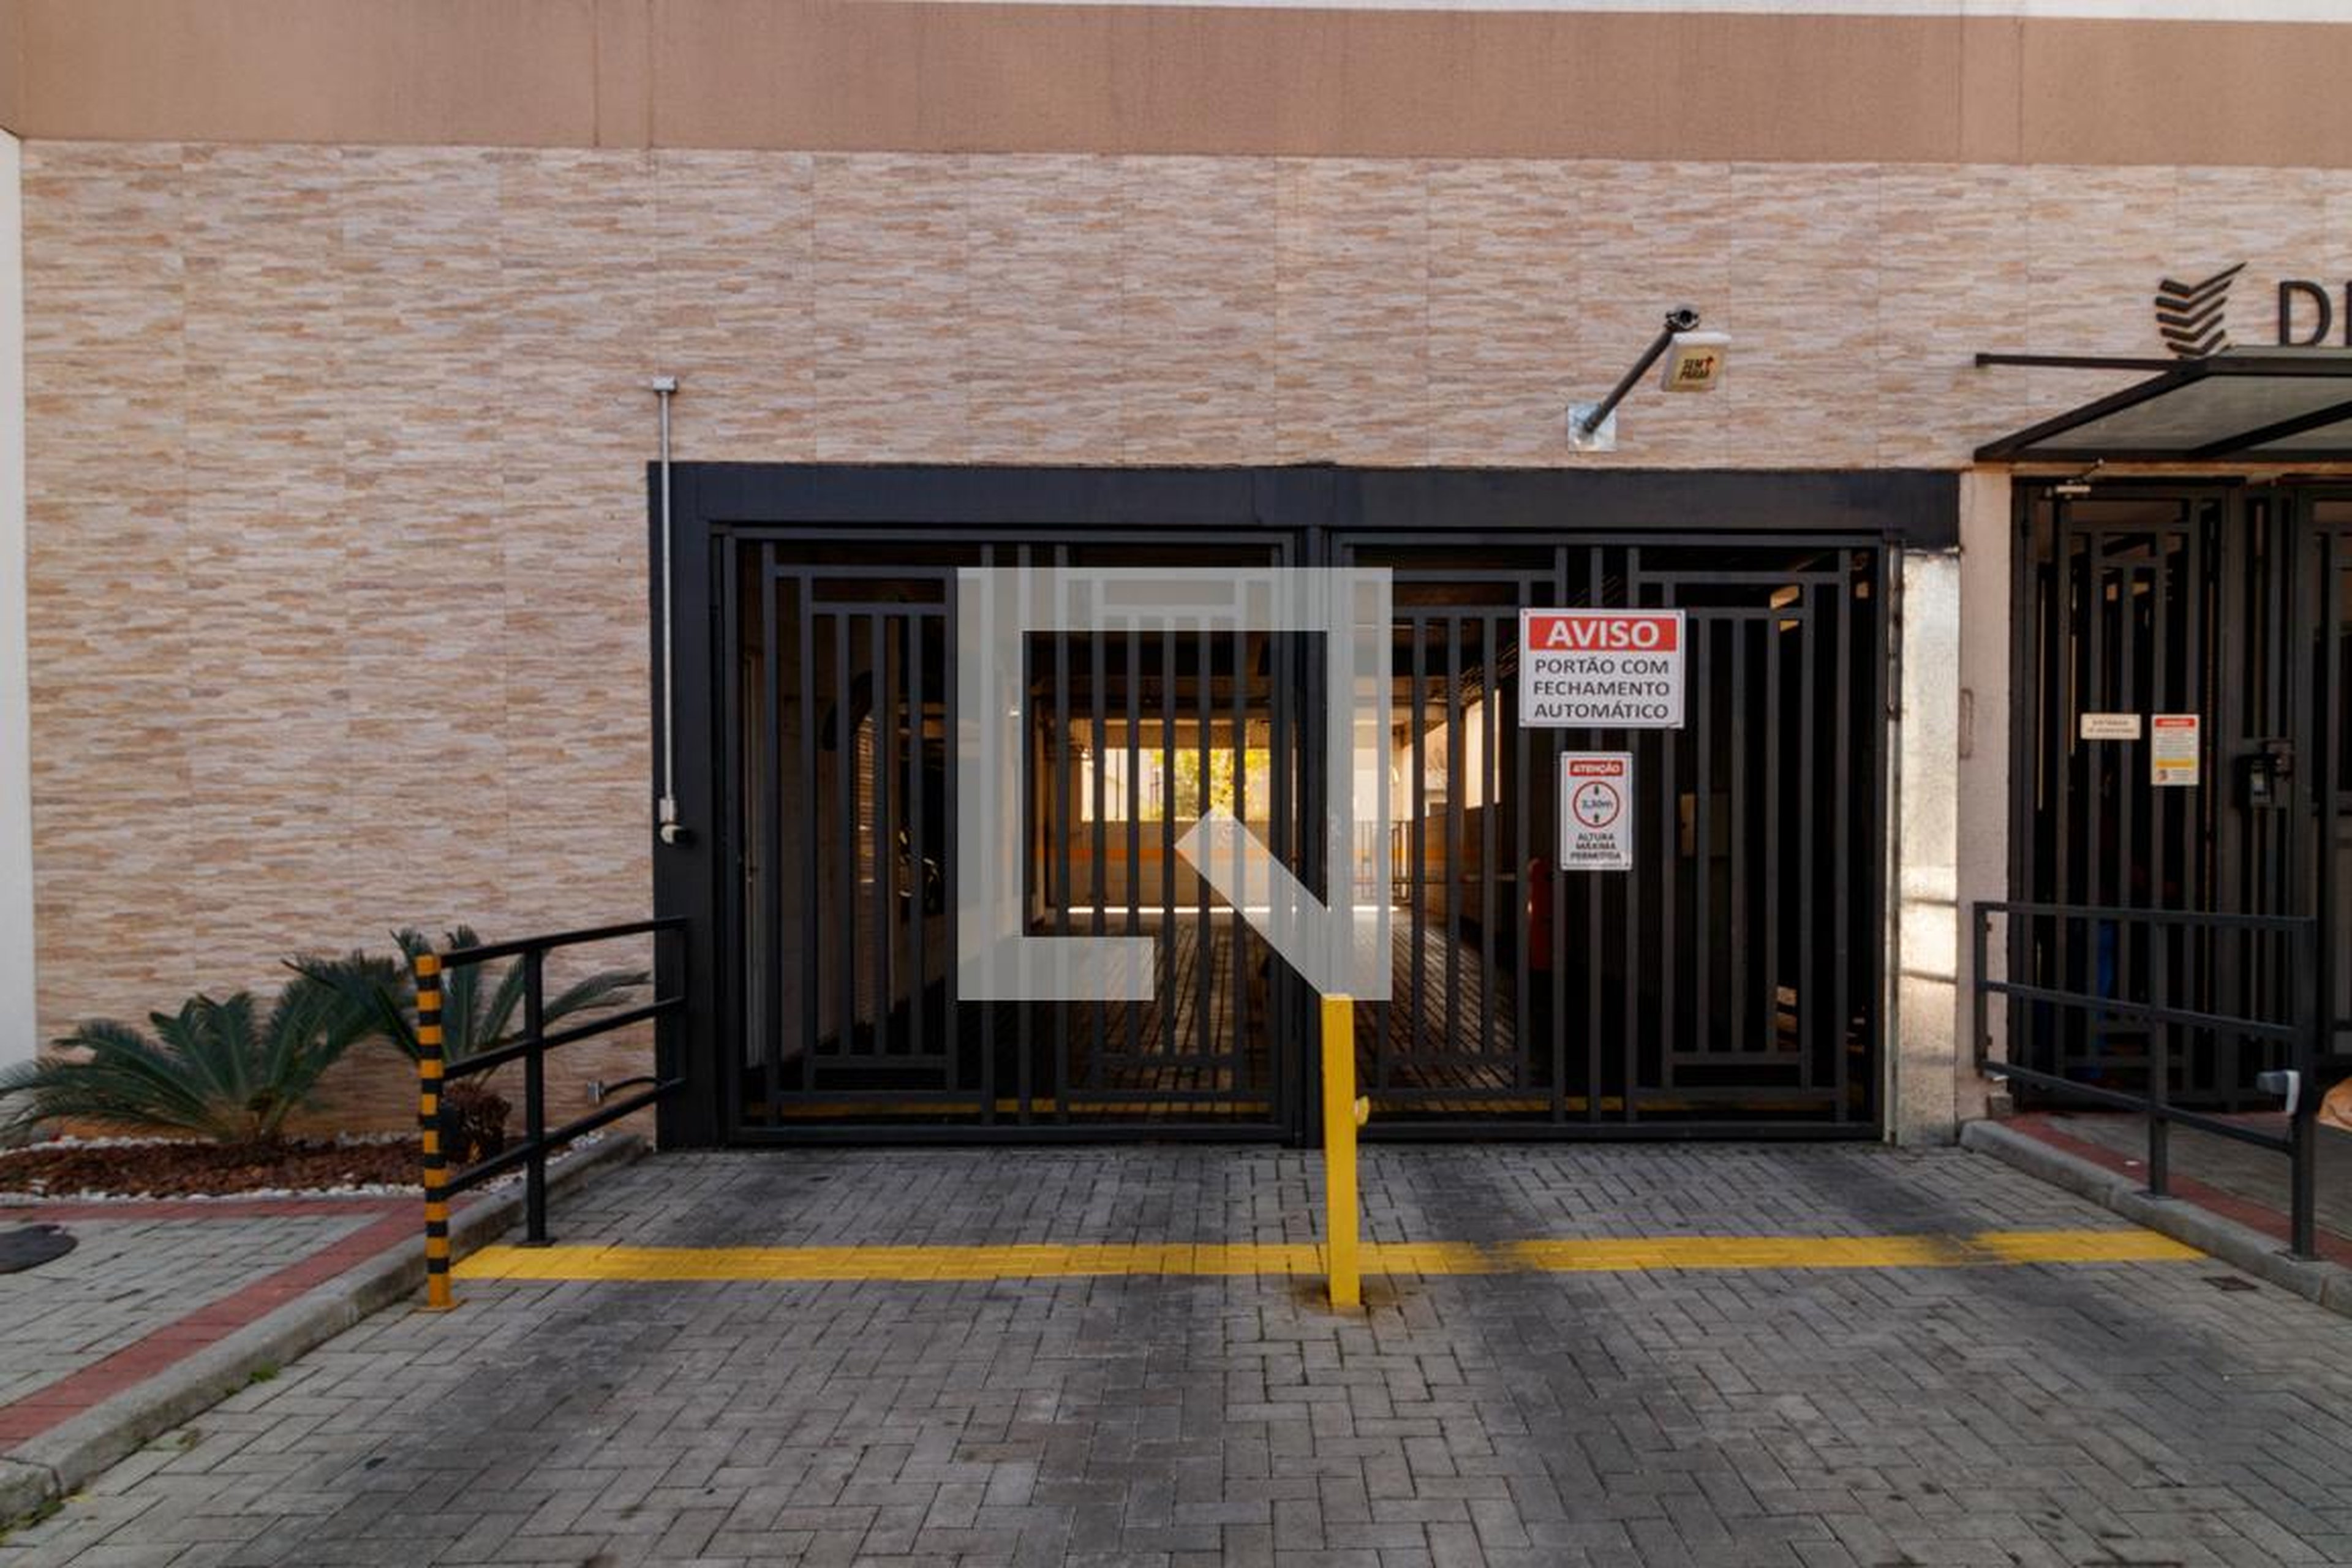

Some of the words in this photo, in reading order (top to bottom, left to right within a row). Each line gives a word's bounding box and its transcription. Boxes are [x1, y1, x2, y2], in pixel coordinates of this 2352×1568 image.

[1546, 620, 1659, 647] AVISO
[1535, 657, 1615, 674] PORTÃO
[1621, 659, 1669, 674] COM
[1534, 680, 1670, 696] FECHAMENTO
[1534, 700, 1668, 718] AUTOMÁTICO
[1572, 763, 1620, 775] ATENÇÃO
[1578, 832, 1615, 841] ALTURA
[1570, 851, 1621, 860] PERMITIDA
